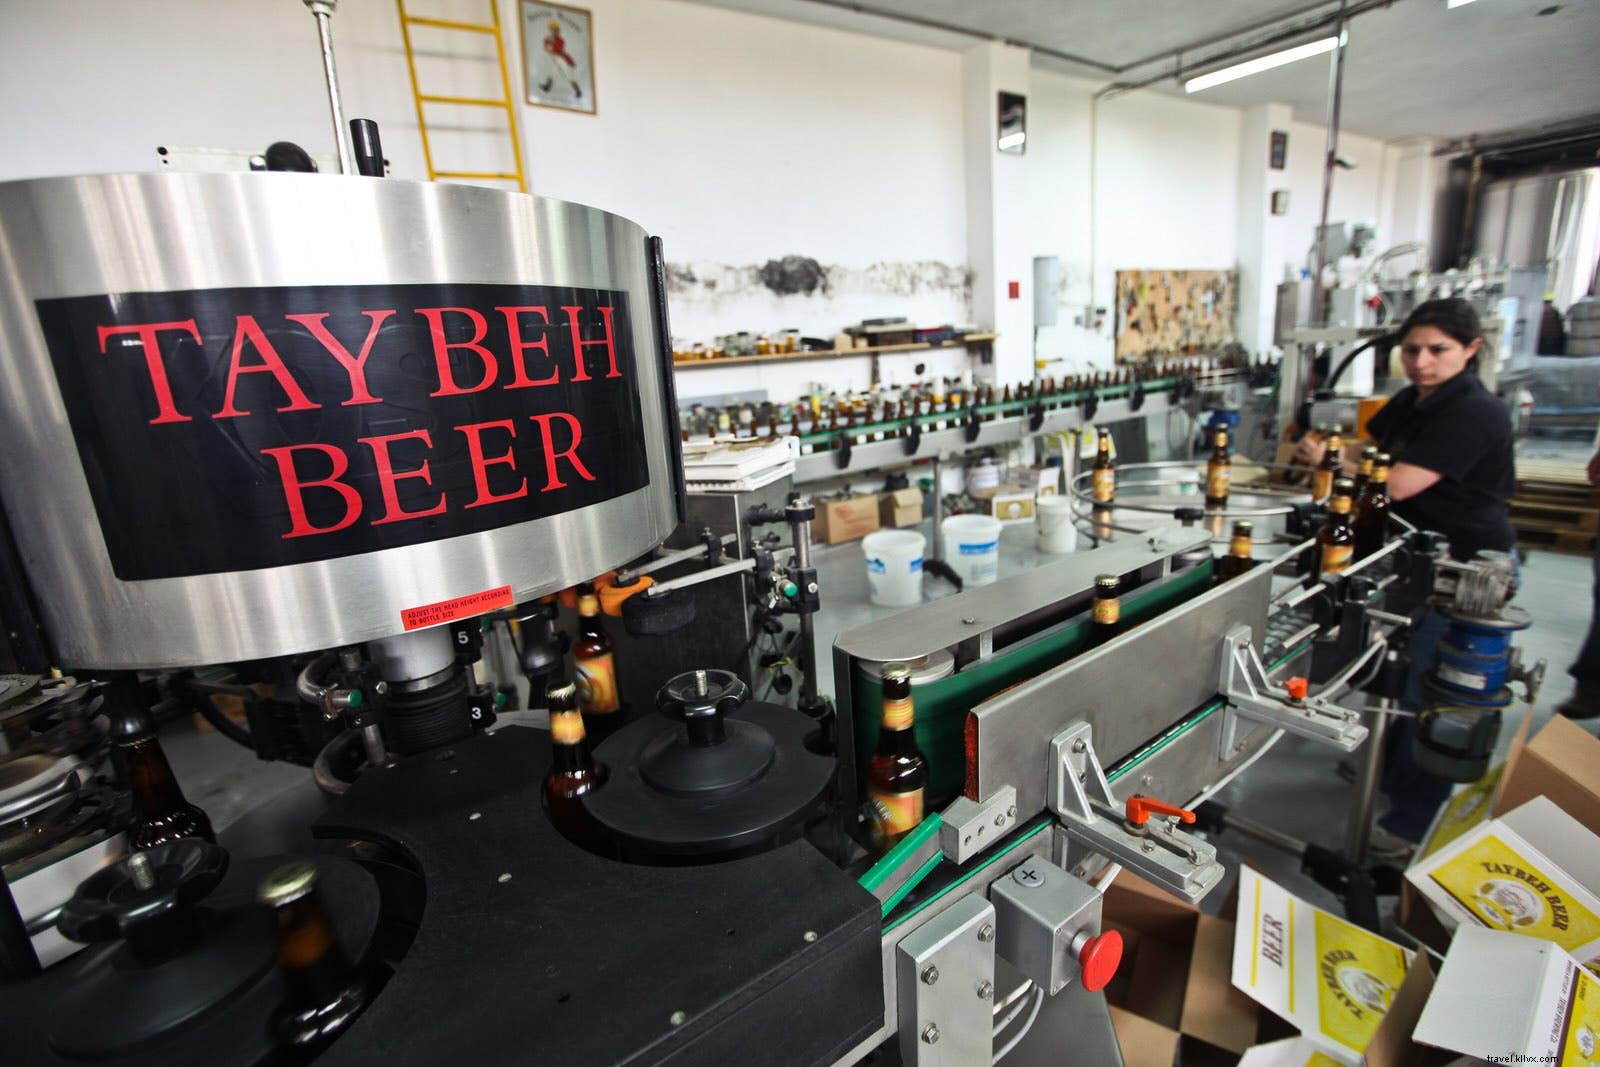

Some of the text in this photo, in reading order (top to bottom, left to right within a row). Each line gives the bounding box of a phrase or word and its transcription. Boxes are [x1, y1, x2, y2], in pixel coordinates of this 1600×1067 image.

[97, 305, 622, 424] TAYBEH
[260, 412, 596, 539] BEER
[407, 589, 510, 620] ADJUST THE HEAD HEIGHT ACCORDING
[409, 610, 454, 626] TO BOTTLE SIZE
[457, 631, 469, 644] 5
[471, 707, 482, 720] 3
[1480, 861, 1570, 931] TAYBEH BEER
[1261, 912, 1284, 968] BEER
